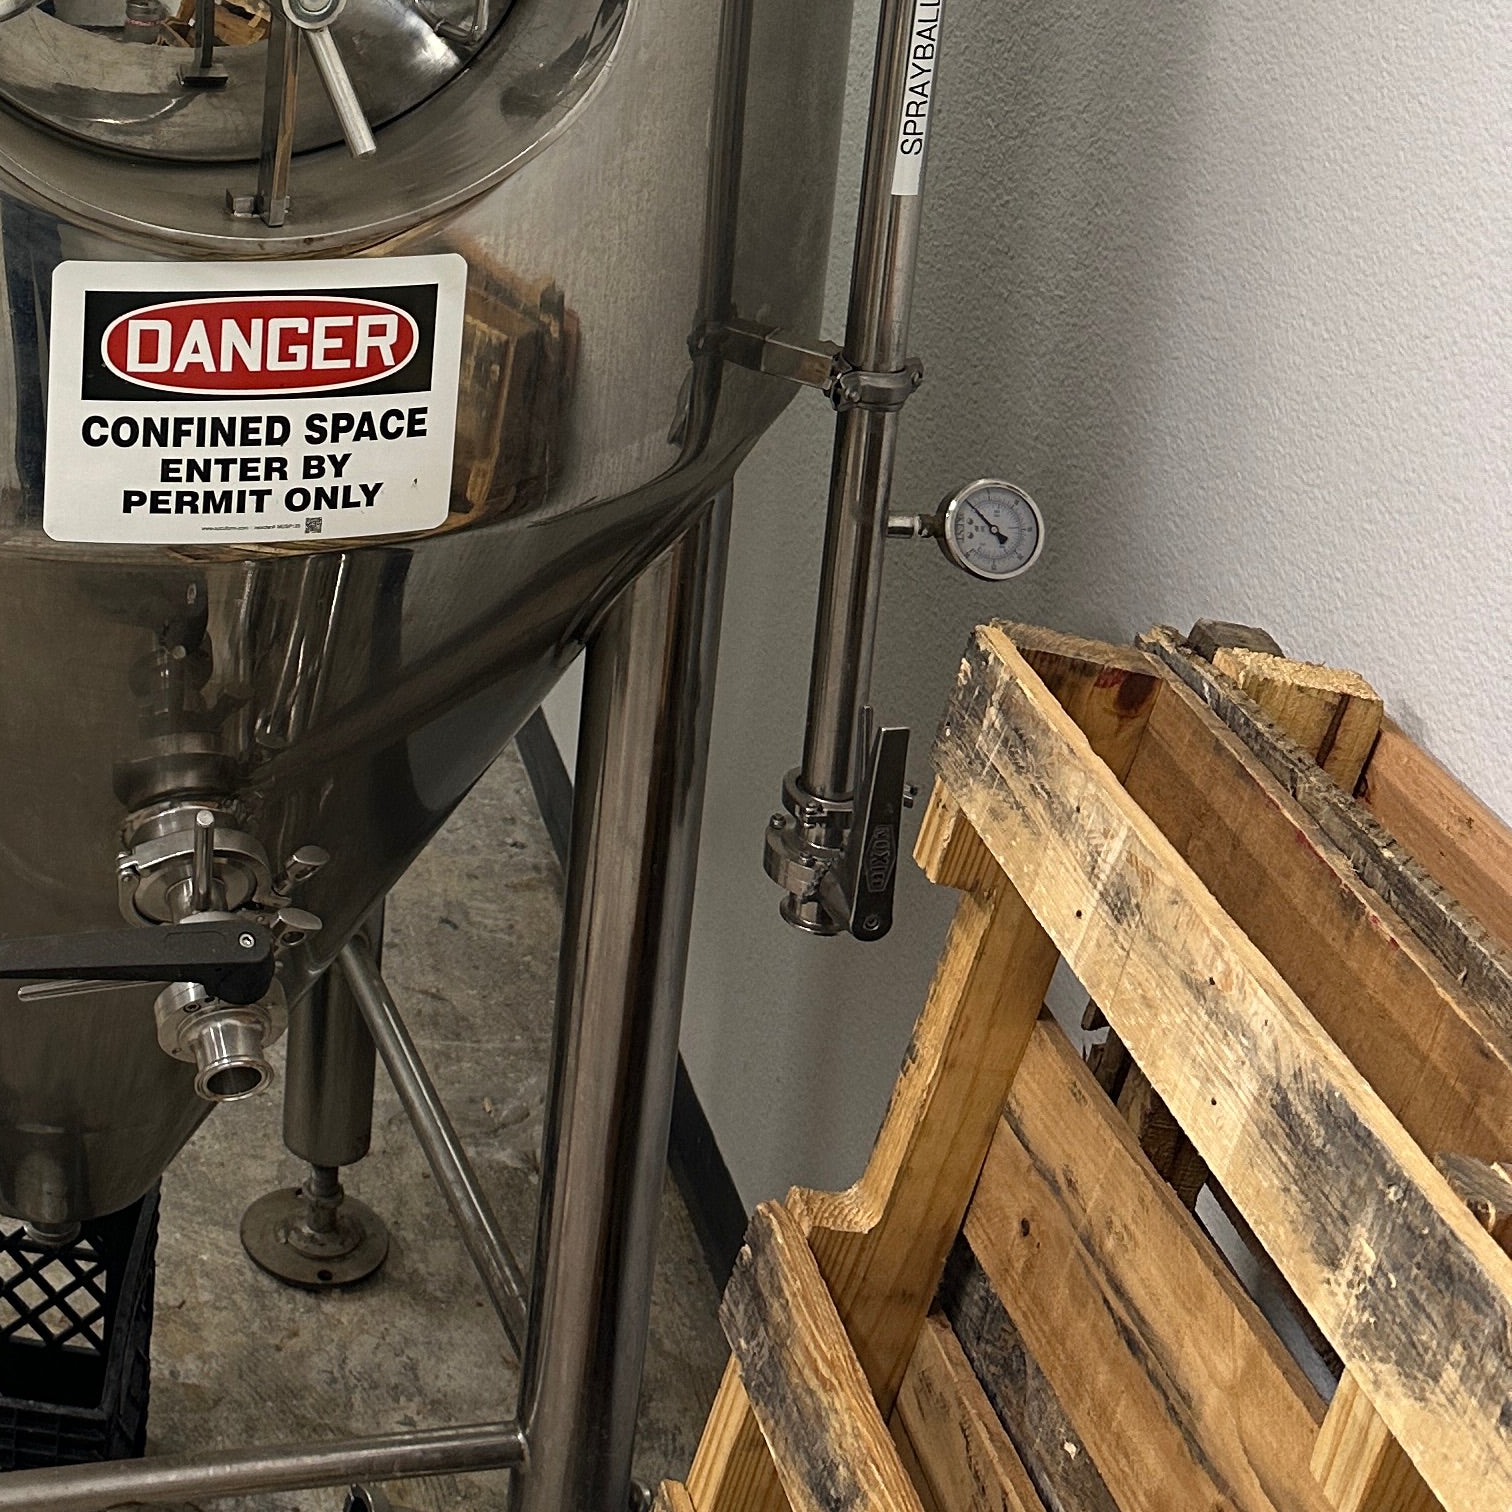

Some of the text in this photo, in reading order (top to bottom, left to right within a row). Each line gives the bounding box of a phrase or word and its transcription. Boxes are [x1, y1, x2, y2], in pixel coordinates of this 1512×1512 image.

[125, 313, 398, 374] DANGER
[81, 406, 429, 448] CONFINED SPACE
[159, 452, 353, 483] ENTER BY
[121, 482, 384, 515] PERMIT ONLY
[870, 824, 892, 887] DIXON
